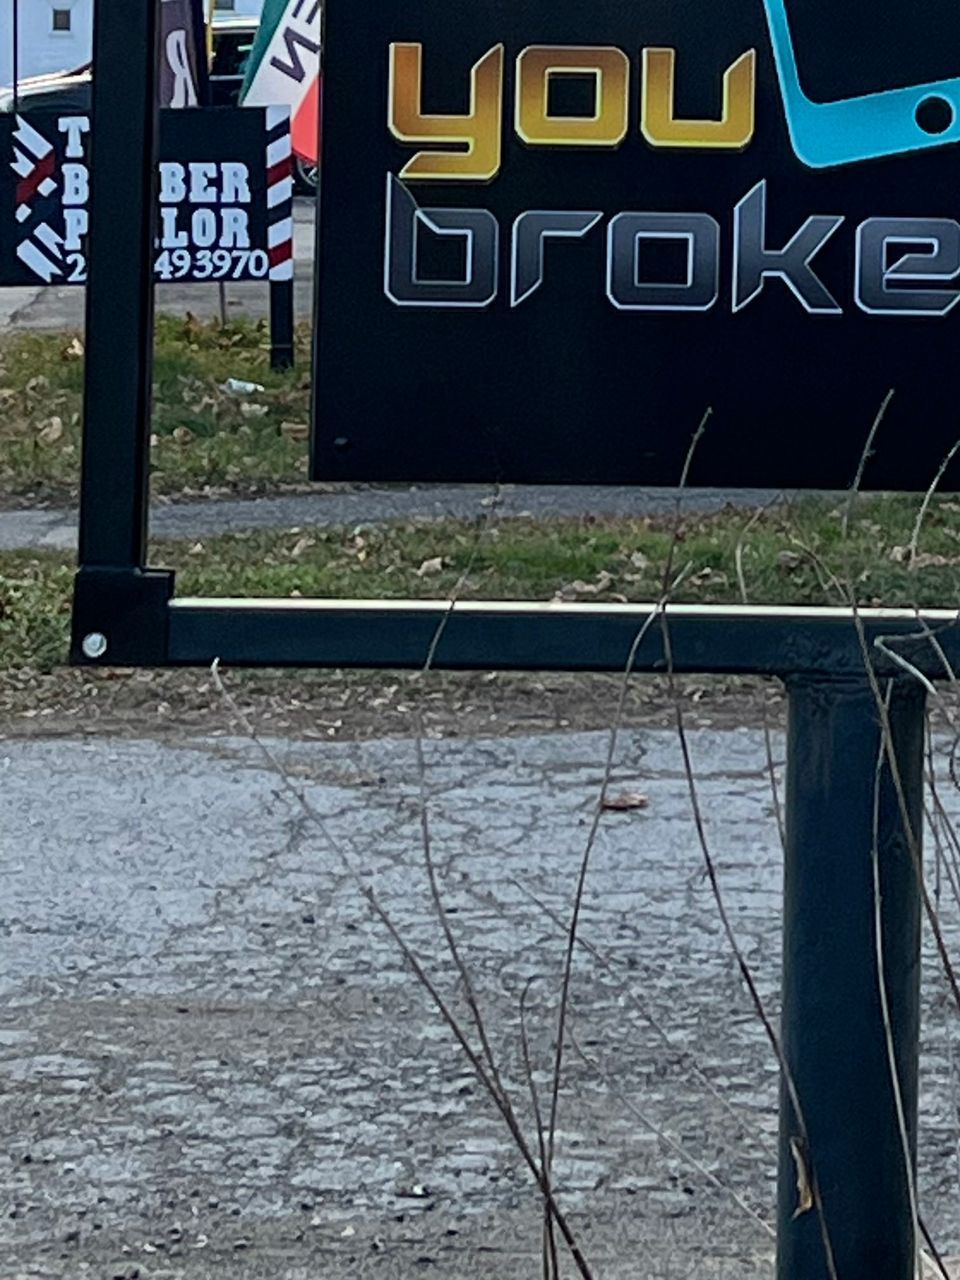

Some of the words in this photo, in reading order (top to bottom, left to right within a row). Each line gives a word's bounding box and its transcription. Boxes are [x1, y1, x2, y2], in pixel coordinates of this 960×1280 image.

[387, 43, 756, 182] you
[61, 162, 251, 203] BBER
[63, 207, 250, 250] PLOR
[66, 249, 269, 280] 2493970
